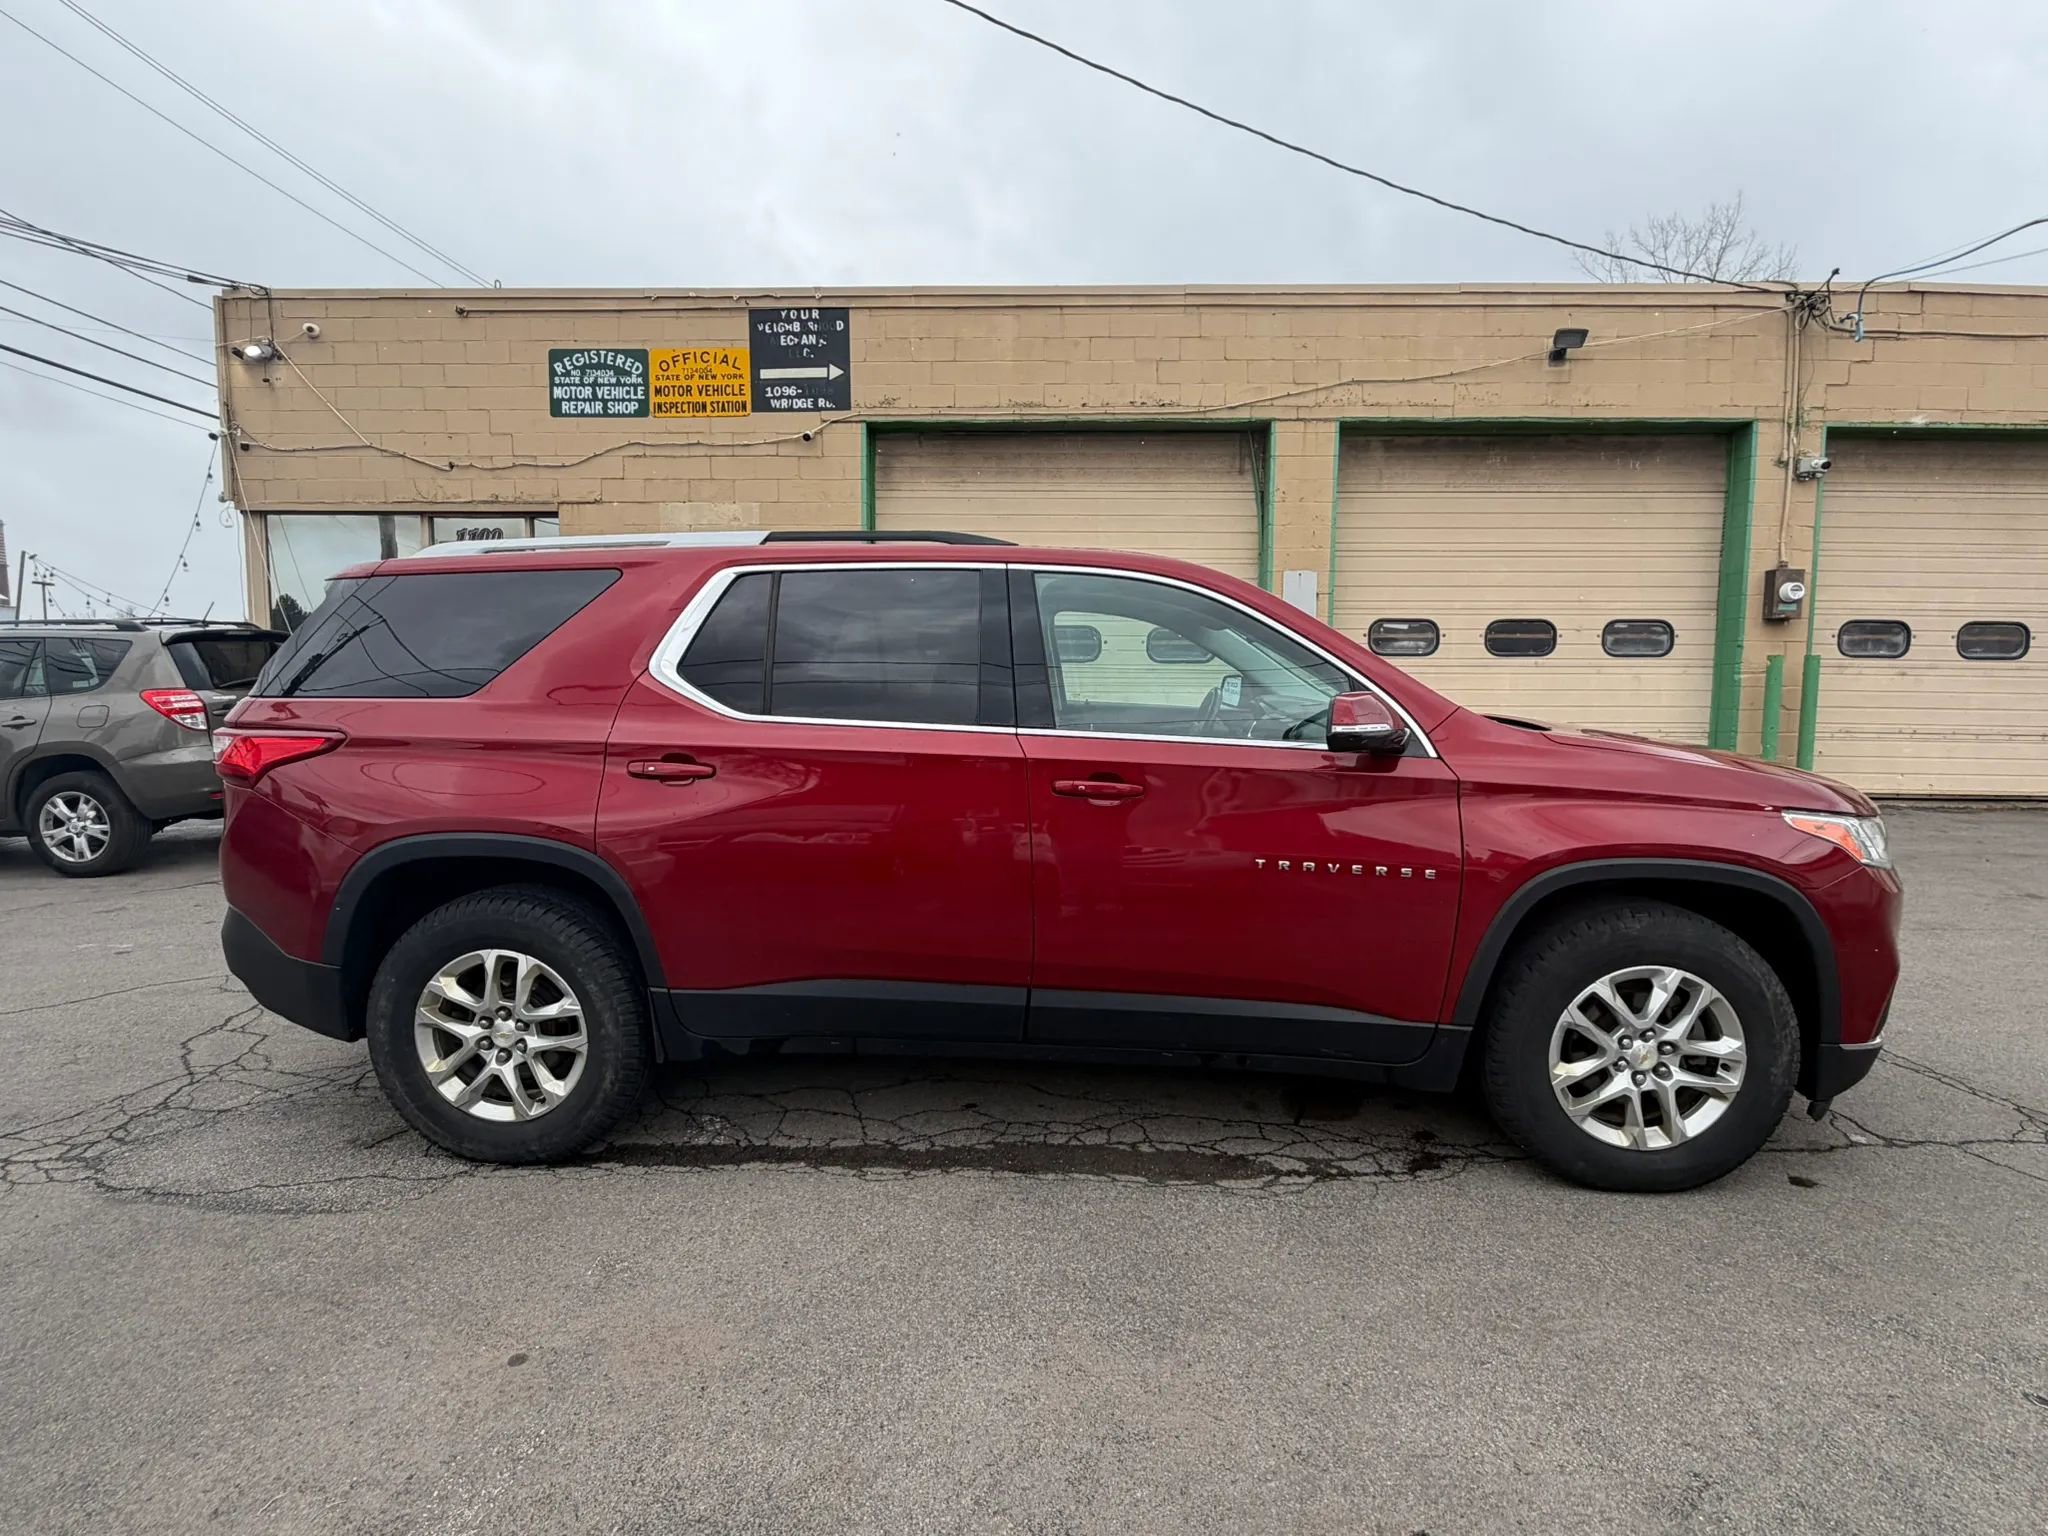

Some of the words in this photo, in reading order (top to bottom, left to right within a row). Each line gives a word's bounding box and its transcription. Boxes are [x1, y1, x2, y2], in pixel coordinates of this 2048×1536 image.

[780, 310, 820, 320] YOUR
[553, 350, 643, 375] REGISTERED
[659, 351, 741, 372] OFFICIAL
[554, 376, 580, 384] STATE
[621, 376, 644, 384] YORK
[554, 386, 592, 399] MOTOR
[596, 386, 645, 399] VEHICLE
[654, 385, 692, 398] MOTOR
[697, 384, 745, 396] VEHICLE
[562, 402, 603, 414] REPAIR
[608, 402, 638, 414] SHOP
[654, 401, 706, 414] INSPECTION
[710, 400, 747, 413] STATION
[456, 528, 504, 541] 1100
[1256, 859, 1436, 879] TRAVERSE
